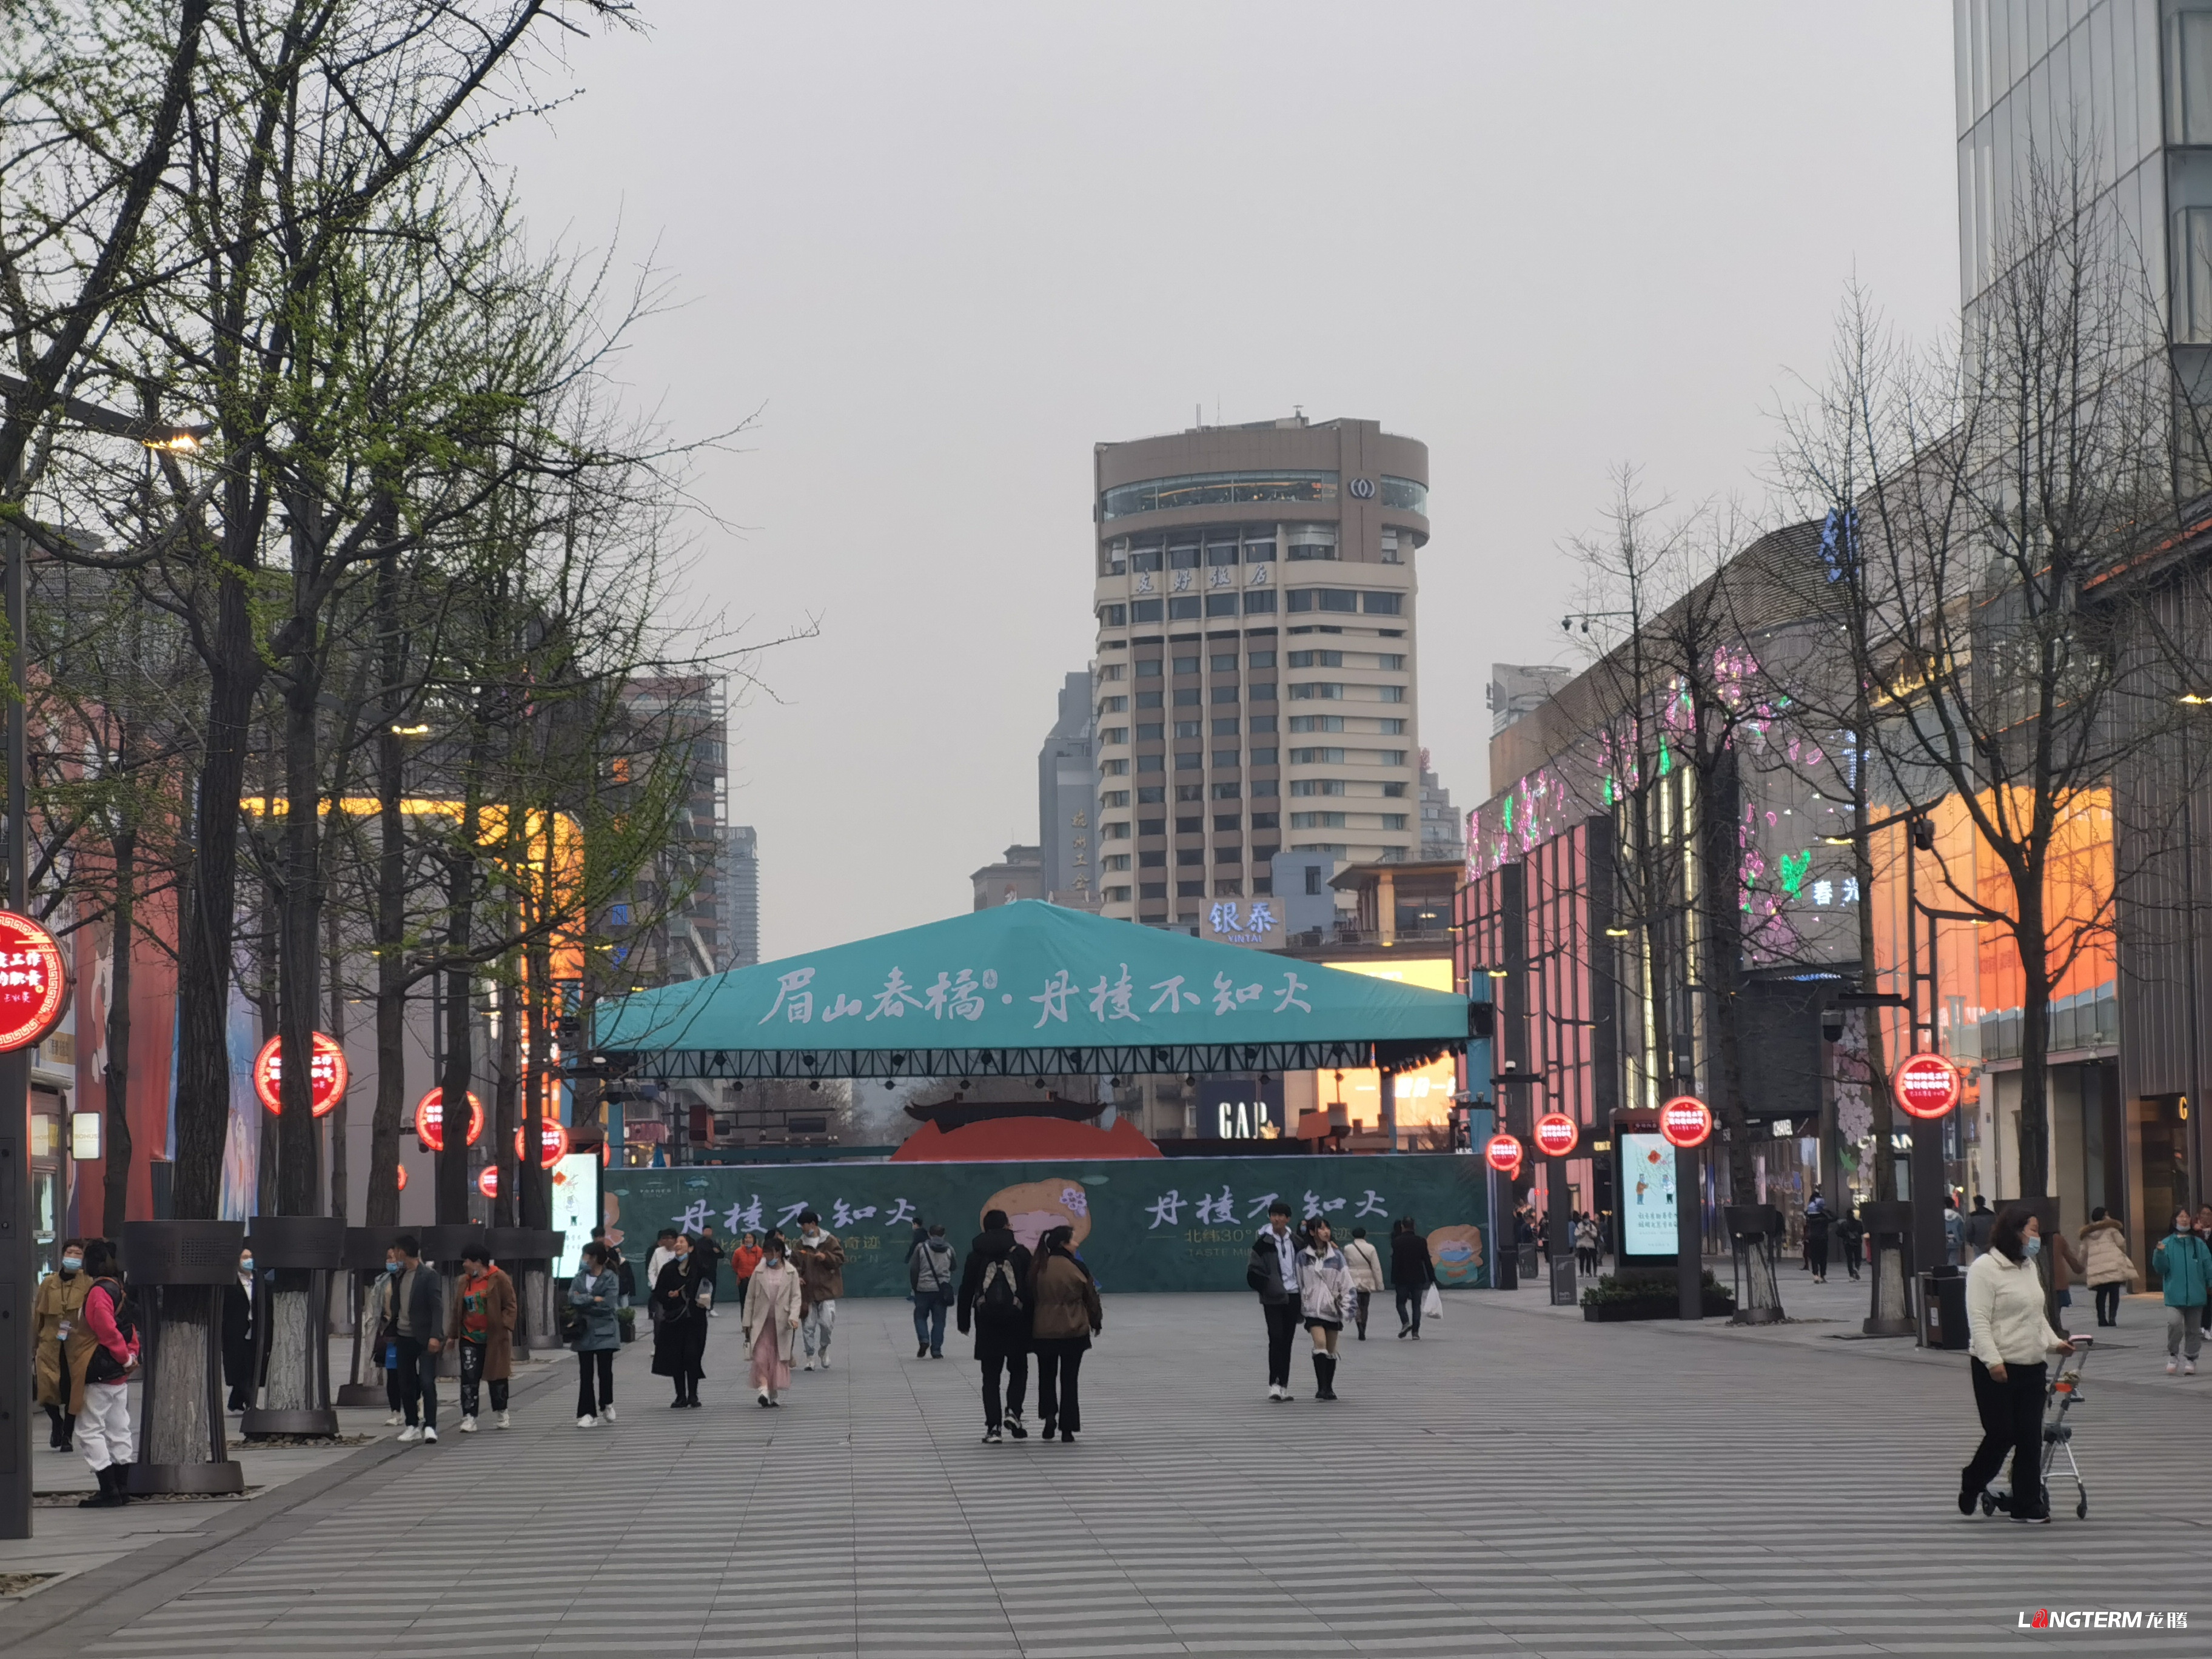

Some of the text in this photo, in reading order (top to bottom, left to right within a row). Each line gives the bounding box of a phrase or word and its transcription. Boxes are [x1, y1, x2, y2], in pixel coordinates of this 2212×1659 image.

[1207, 901, 1279, 934] 银泰
[1227, 934, 1262, 943] YINTAI
[1218, 1102, 1269, 1139] GAP
